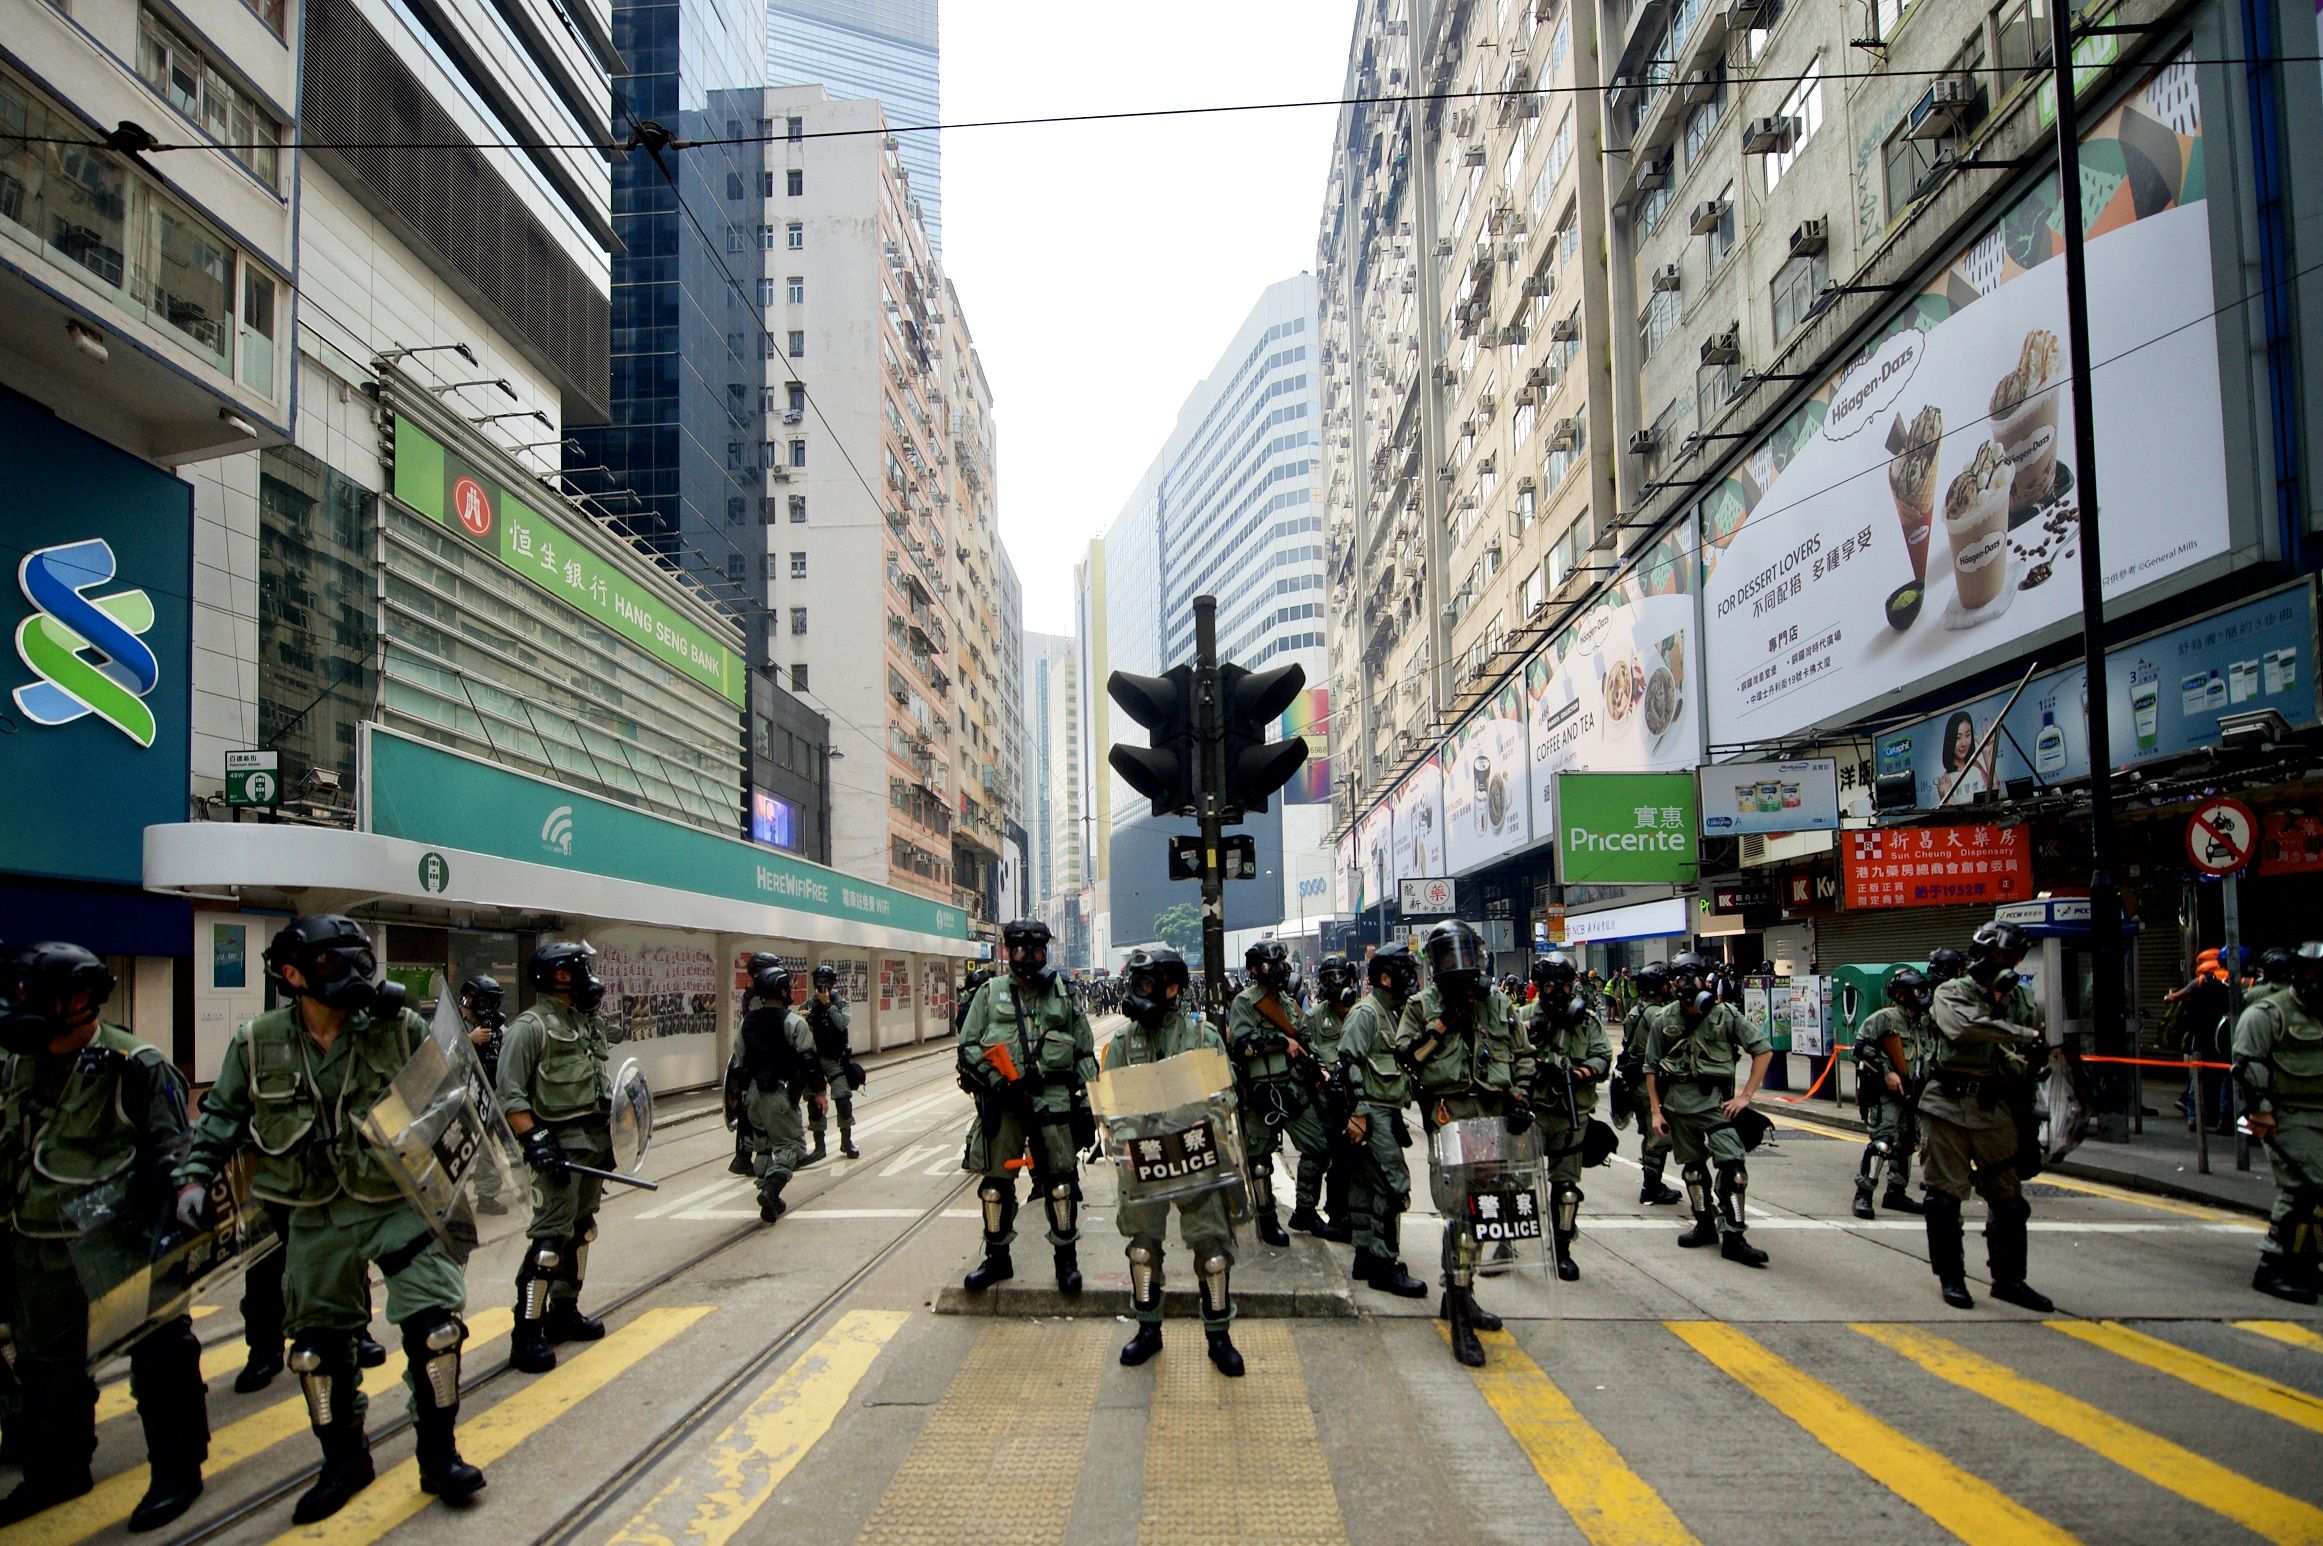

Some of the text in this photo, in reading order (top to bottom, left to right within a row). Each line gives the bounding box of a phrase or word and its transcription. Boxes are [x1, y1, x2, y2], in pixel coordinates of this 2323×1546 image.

[1832, 346, 1914, 425] Häagen-Dazs
[2178, 540, 2198, 555] Mills
[1717, 533, 1821, 619] FOR DESSERT LOVERS
[1753, 524, 1872, 618] 不同配搭 多種享受
[509, 519, 720, 677] 恒生銀行 HANG SENG BANK
[1768, 625, 1798, 652] 專門店
[2129, 671, 2137, 683] 3
[1536, 733, 1561, 762] COFFEE
[1562, 722, 1578, 748] AND
[1580, 711, 1595, 735] TEA
[1634, 804, 1685, 829] 實惠
[1570, 827, 1686, 852] Pricerite
[1889, 826, 2018, 851] 新昌大藥房
[1890, 848, 2014, 860] Sun Cheung Dispensary
[1299, 877, 1327, 898] SOGO
[1430, 884, 1447, 901] 藥
[2074, 907, 2090, 915] PCC
[1572, 924, 1585, 935] NCB
[449, 1089, 490, 1178] POLCE
[1138, 1128, 1206, 1162] 警察
[1139, 1150, 1217, 1180] POLICE
[1477, 1193, 1533, 1219] 警察
[1475, 1220, 1540, 1240] POLICE
